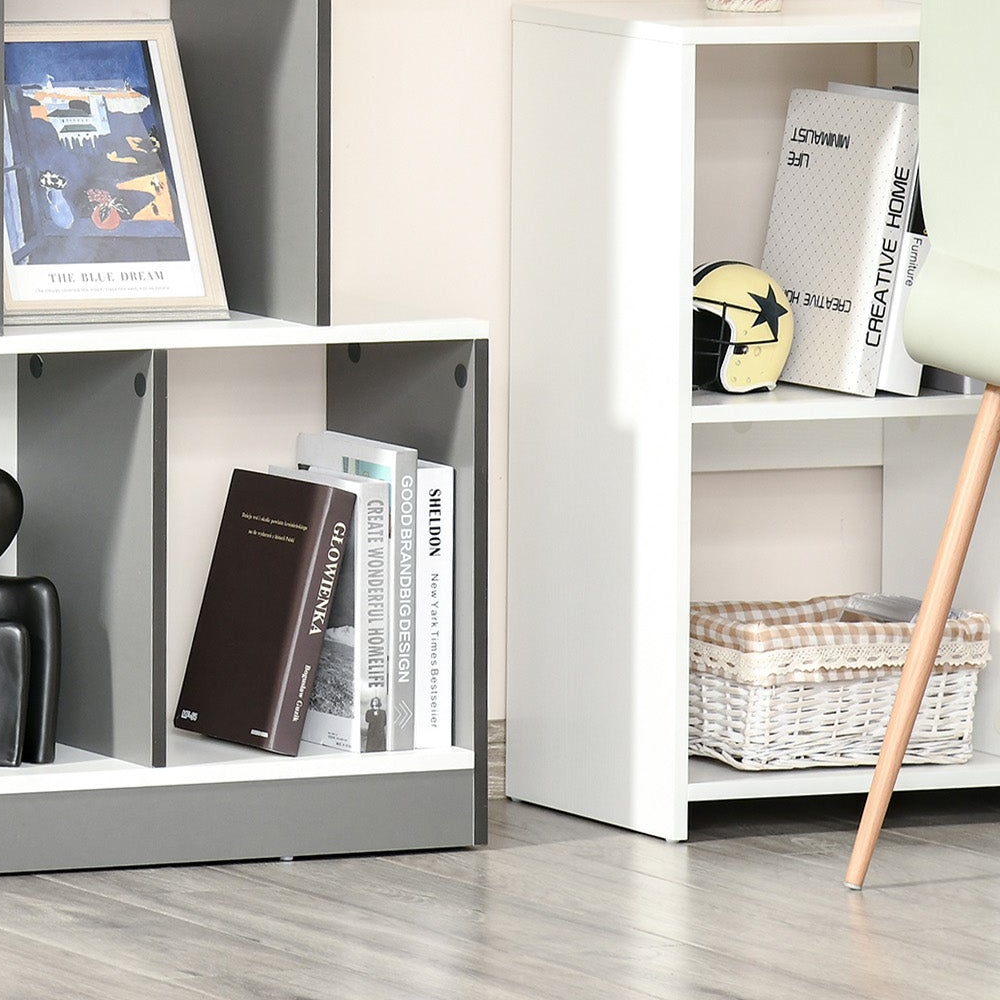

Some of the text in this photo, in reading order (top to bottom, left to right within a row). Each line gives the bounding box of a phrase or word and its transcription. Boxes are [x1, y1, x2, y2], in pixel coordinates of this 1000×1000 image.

[791, 127, 850, 149] MINIMALIST
[787, 151, 810, 168] LIFE
[865, 165, 910, 347] CREATIVE HOME
[904, 236, 923, 288] Furniture
[47, 270, 165, 284] THE BLUE DREAM
[803, 292, 851, 313] CREATIVE
[428, 488, 442, 557] SHELDON
[309, 521, 347, 636] GŁOWIENKA
[367, 499, 385, 689] CREATE WONDERFUL HOMELIFE
[430, 573, 439, 598] New
[430, 631, 439, 666] Times
